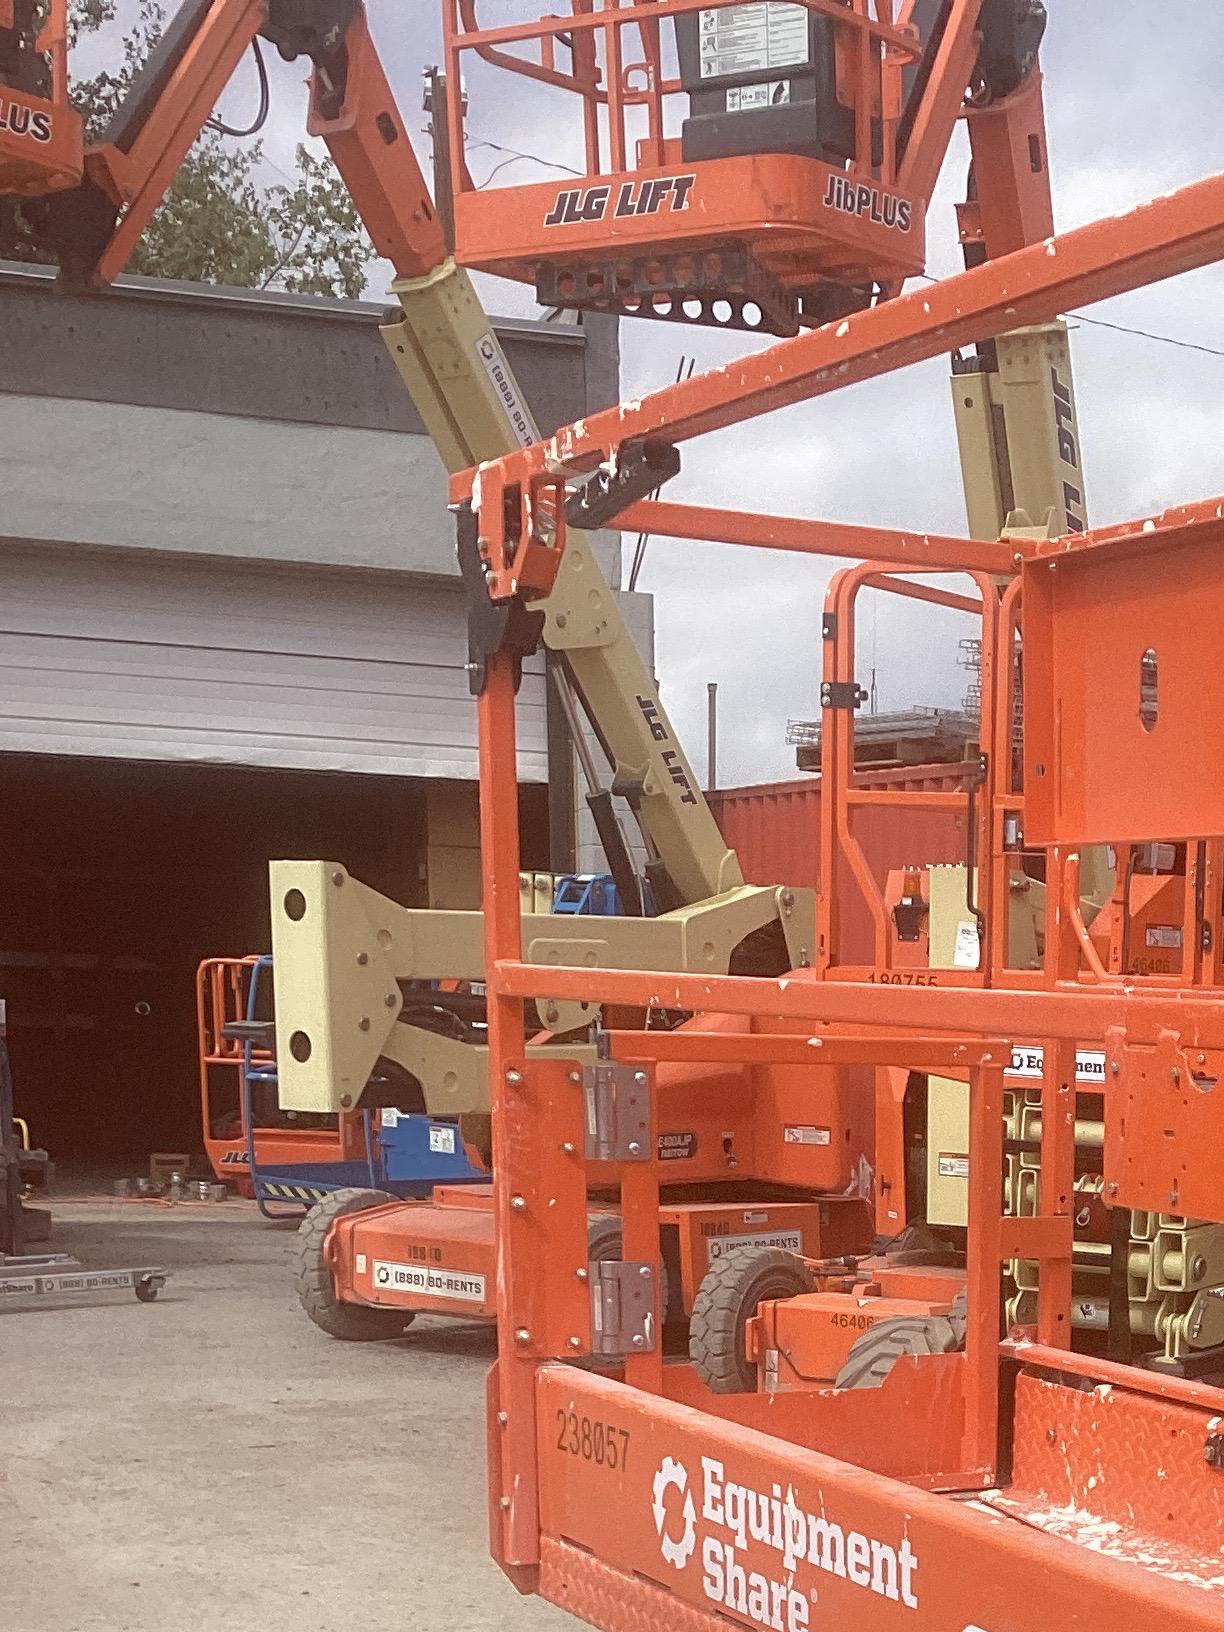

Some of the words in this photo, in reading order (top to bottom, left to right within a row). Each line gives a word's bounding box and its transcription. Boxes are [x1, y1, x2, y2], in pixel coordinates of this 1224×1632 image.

[543, 184, 611, 227] JLG
[613, 173, 697, 219] LIFT
[823, 174, 913, 233] JibPLUS
[1050, 365, 1078, 469] JLG
[635, 694, 669, 742] JLG
[660, 749, 698, 805] LIFT
[394, 1270, 425, 1288] (888)
[427, 1275, 482, 1294] 80-RENTS
[556, 1408, 631, 1474] 238057
[701, 1455, 919, 1610] Equipment
